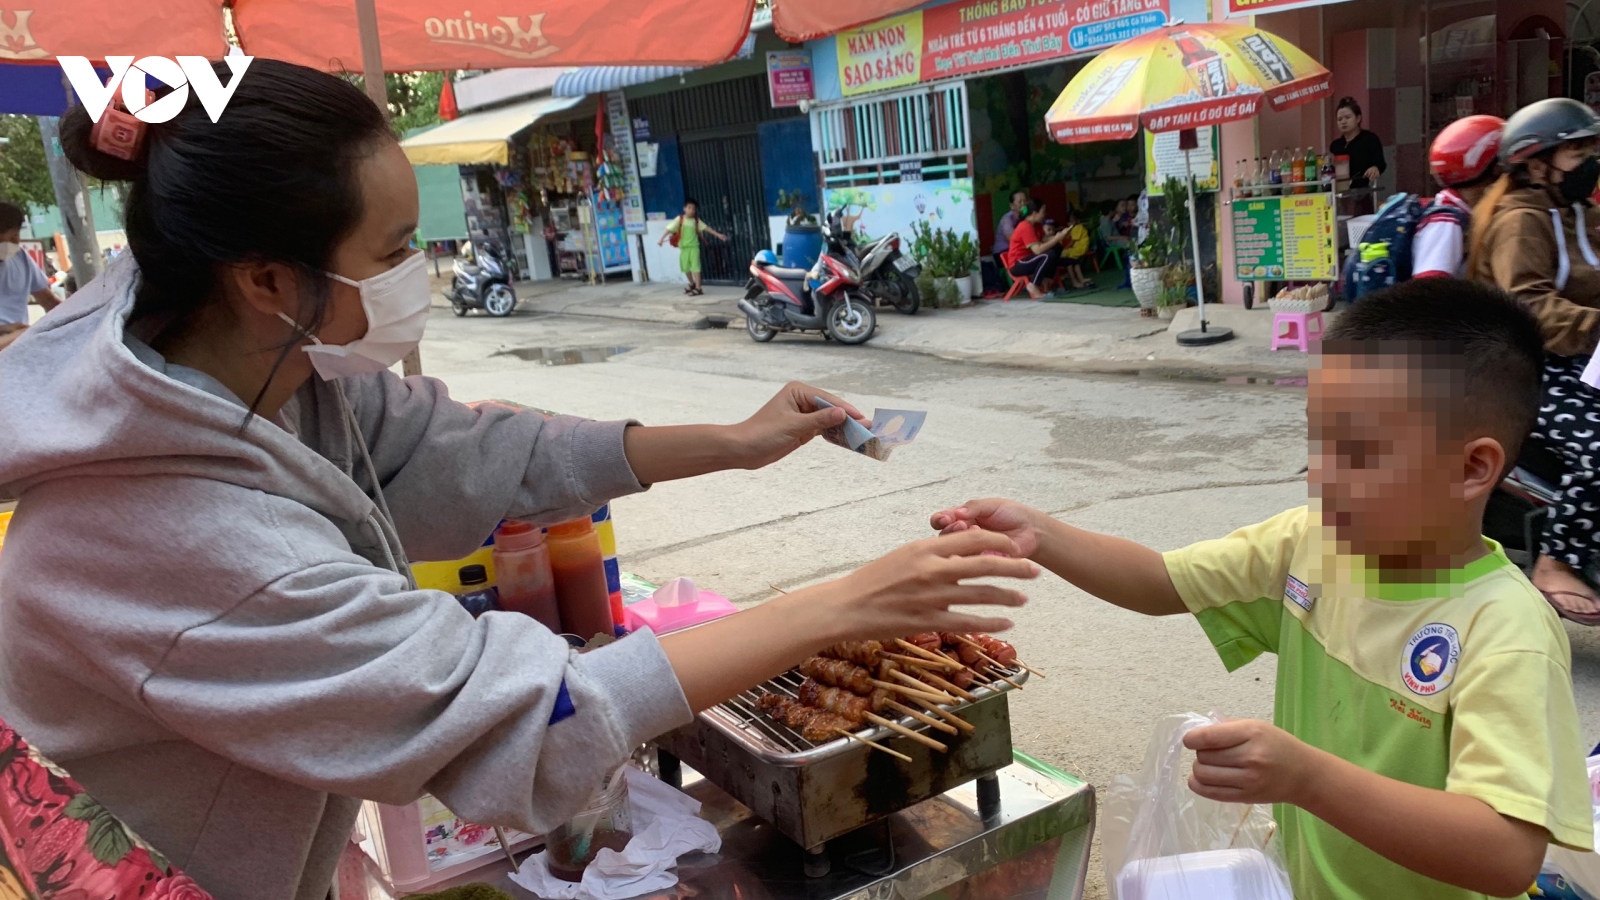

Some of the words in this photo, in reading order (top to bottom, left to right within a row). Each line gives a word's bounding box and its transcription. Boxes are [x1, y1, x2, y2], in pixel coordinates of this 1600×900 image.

[959, 1, 998, 23] THÔNG
[950, 27, 965, 48] TRẺ
[967, 25, 979, 44] TỪ
[980, 28, 986, 42] 6
[987, 20, 1016, 41] THÁNG
[1018, 12, 1036, 35] ĐẾN
[1038, 16, 1044, 31] 4
[1045, 3, 1069, 29] TUỔI
[1076, 1, 1090, 23] CÓ
[878, 24, 906, 50] NON
[1001, 40, 1020, 59] Đến
[1021, 36, 1041, 56] Thứ
[1042, 31, 1063, 53] Bảy
[844, 61, 872, 87] SAO
[875, 52, 915, 80] SÁNG
[1149, 115, 1170, 130] ĐẬP
[1172, 111, 1191, 126] TAN
[1408, 626, 1443, 647] TRƯỜNG
[1404, 671, 1420, 691] VĨNH
